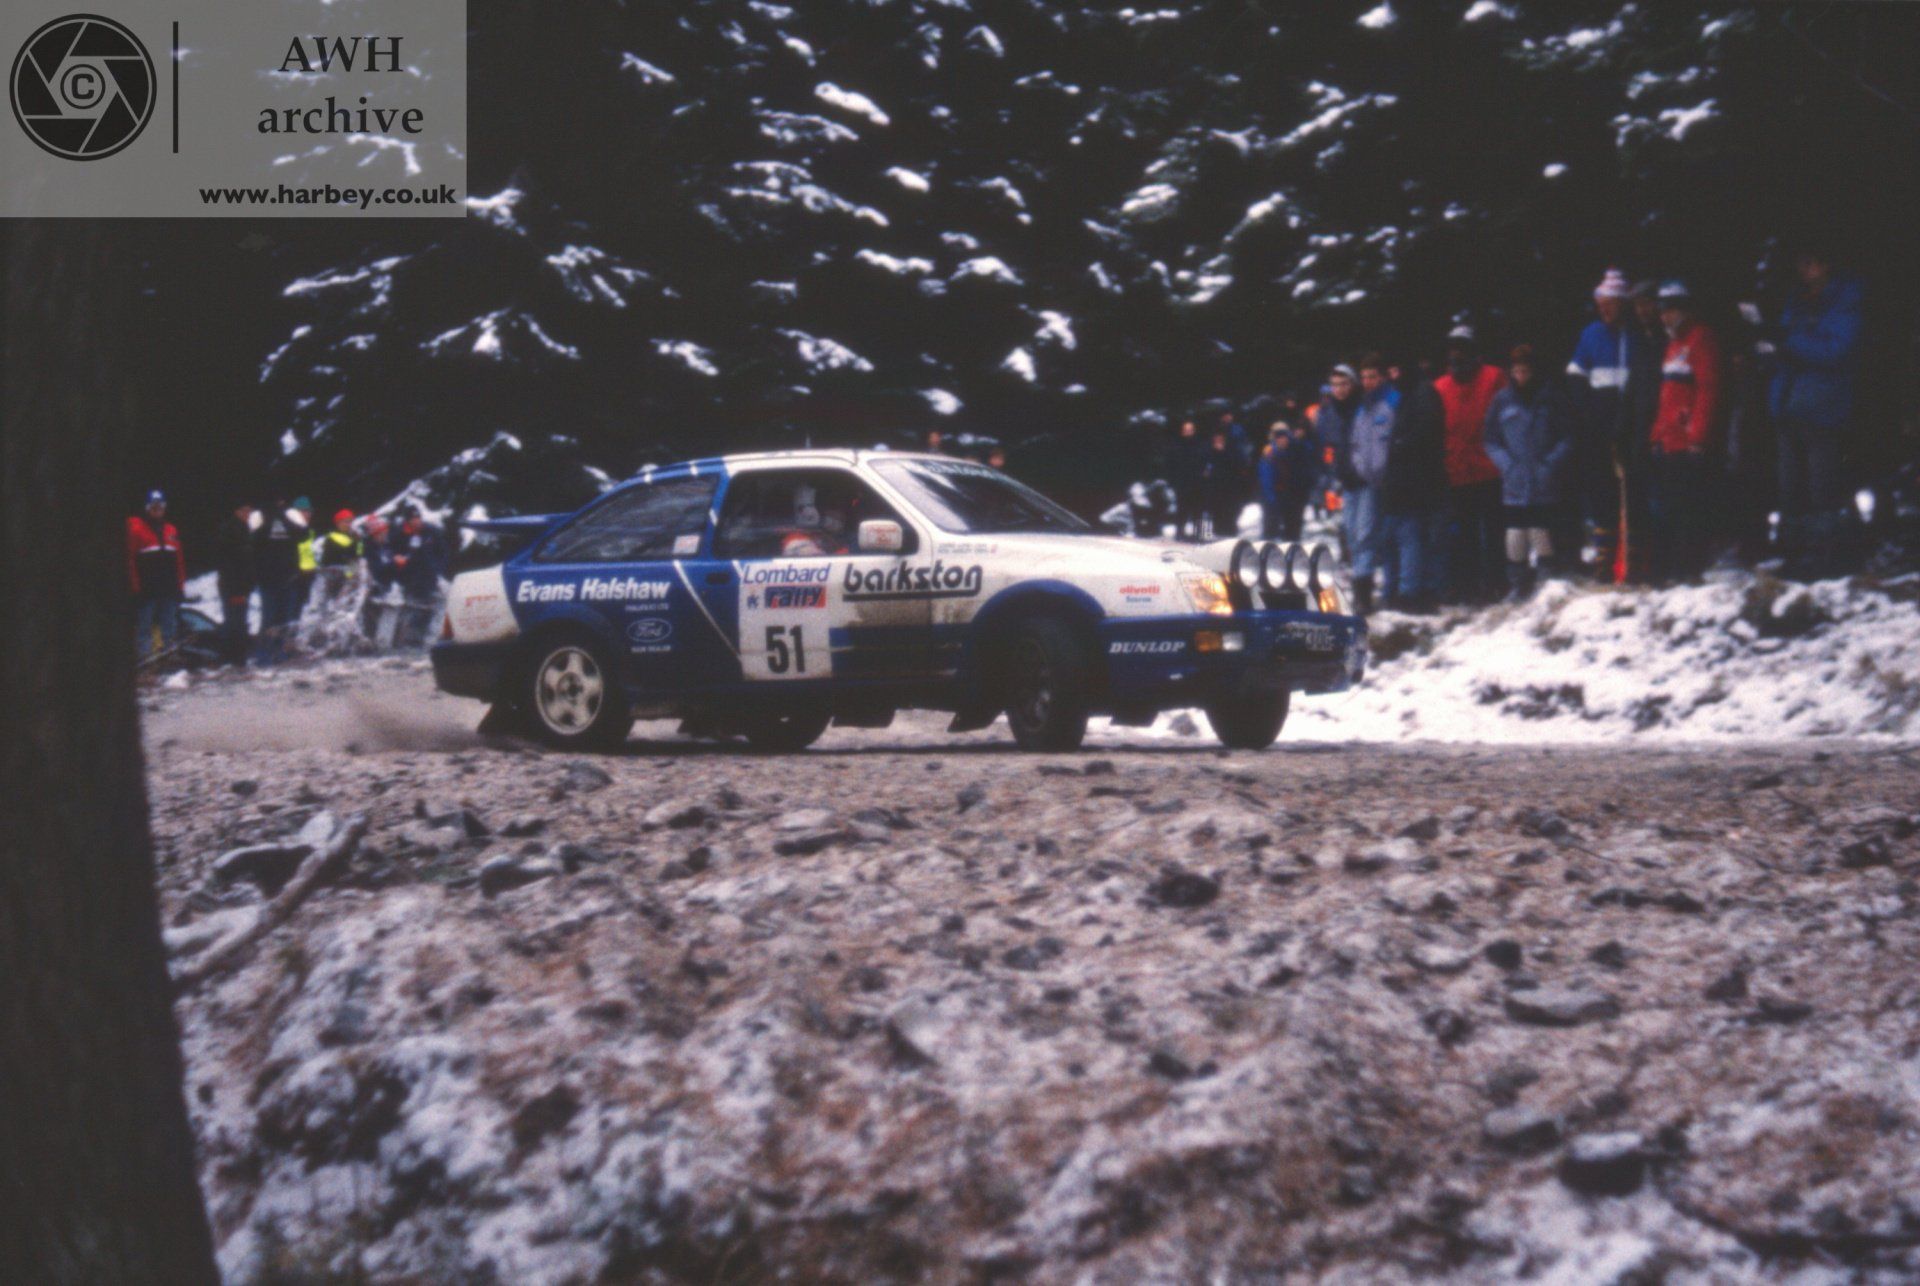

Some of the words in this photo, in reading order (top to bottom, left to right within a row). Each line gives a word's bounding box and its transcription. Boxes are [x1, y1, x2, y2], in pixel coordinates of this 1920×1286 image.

[743, 563, 830, 583] Lombard
[843, 560, 982, 597] barkston
[517, 580, 574, 603] Evans
[581, 577, 670, 600] Halshaw
[766, 625, 805, 673] 51
[1109, 641, 1186, 654] DUNLOP
